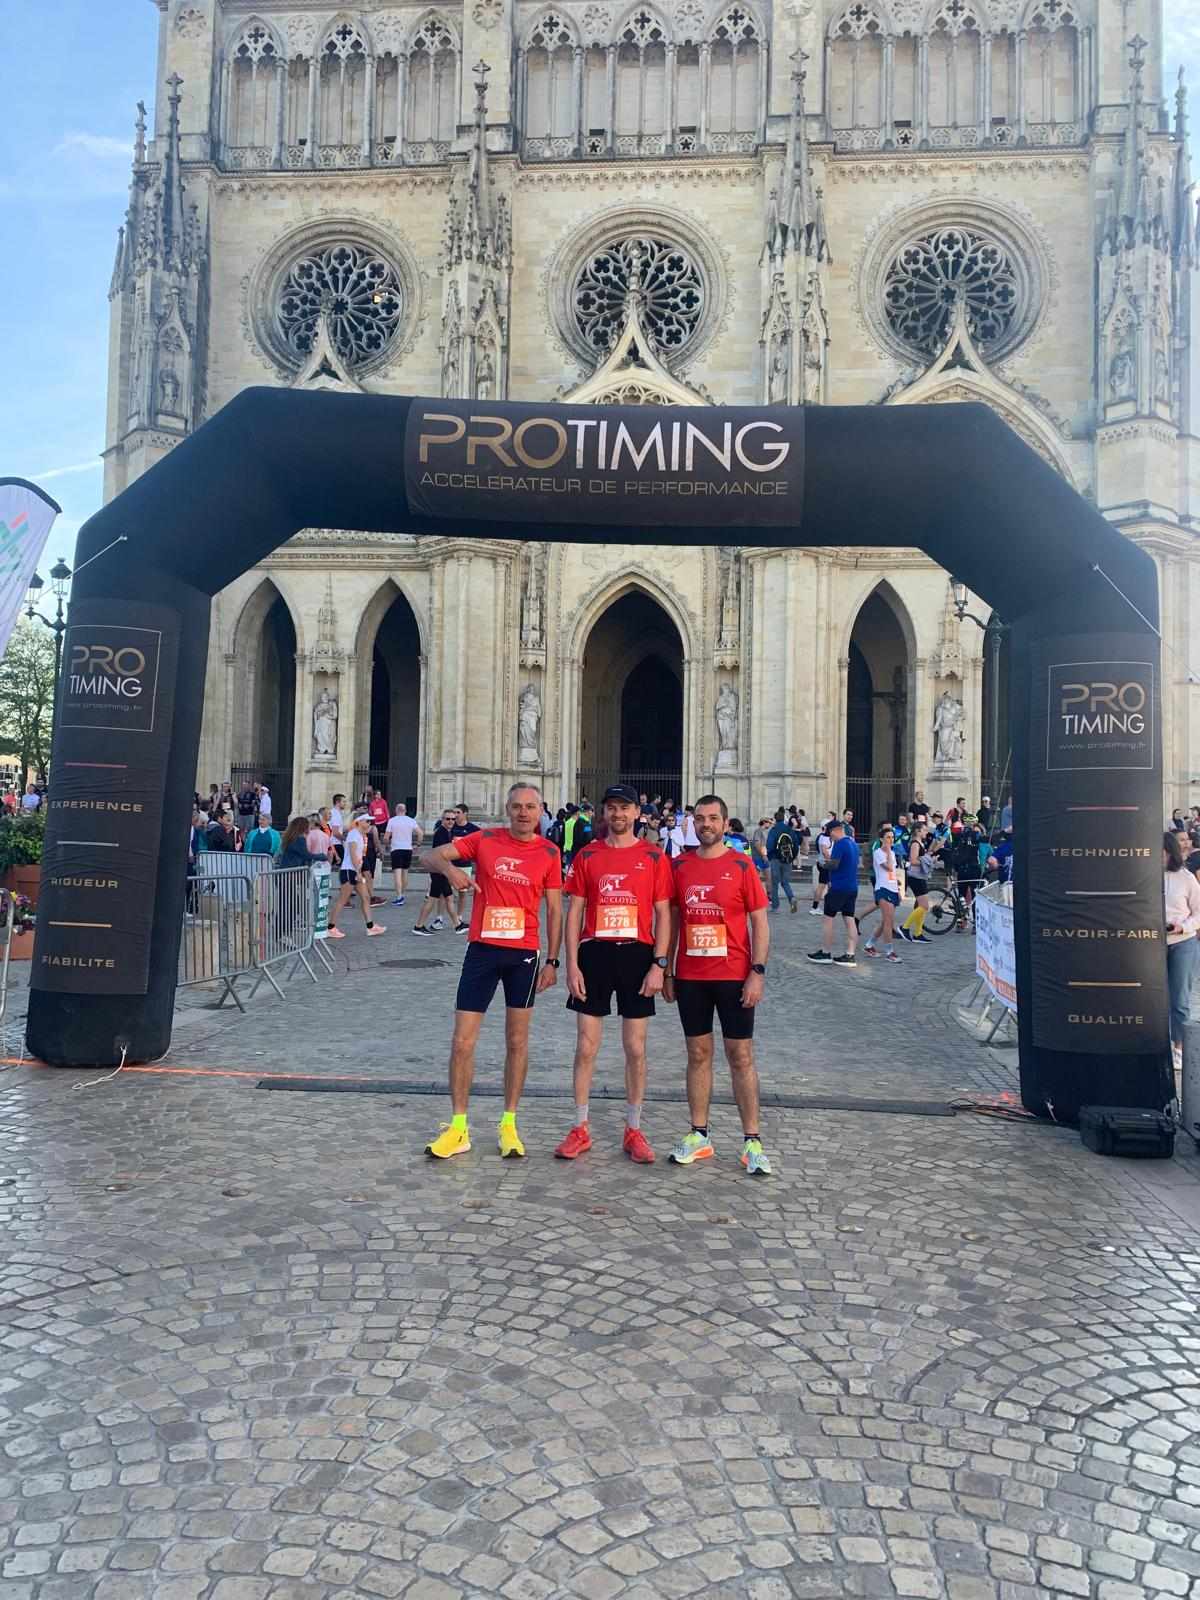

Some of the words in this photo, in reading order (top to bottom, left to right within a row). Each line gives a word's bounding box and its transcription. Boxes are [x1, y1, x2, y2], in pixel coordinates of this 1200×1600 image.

[419, 413, 790, 473] PROTIMING
[589, 479, 617, 494] DE
[624, 480, 788, 496] PERFORMANCE
[71, 645, 146, 676] PRO
[69, 675, 143, 697] TIMING
[1061, 682, 1145, 713] PRO
[1061, 713, 1145, 735] TIMING
[51, 800, 144, 812] EXPERIENCE
[1051, 848, 1151, 857] TECHNICITE
[51, 877, 118, 889] RIGUEUR
[491, 918, 517, 928] 1362
[1042, 929, 1159, 939] SAVOIR-FAIRE
[692, 936, 718, 946] 1273
[42, 955, 115, 968] FIABILITE
[1068, 1014, 1144, 1025] QUALITE
